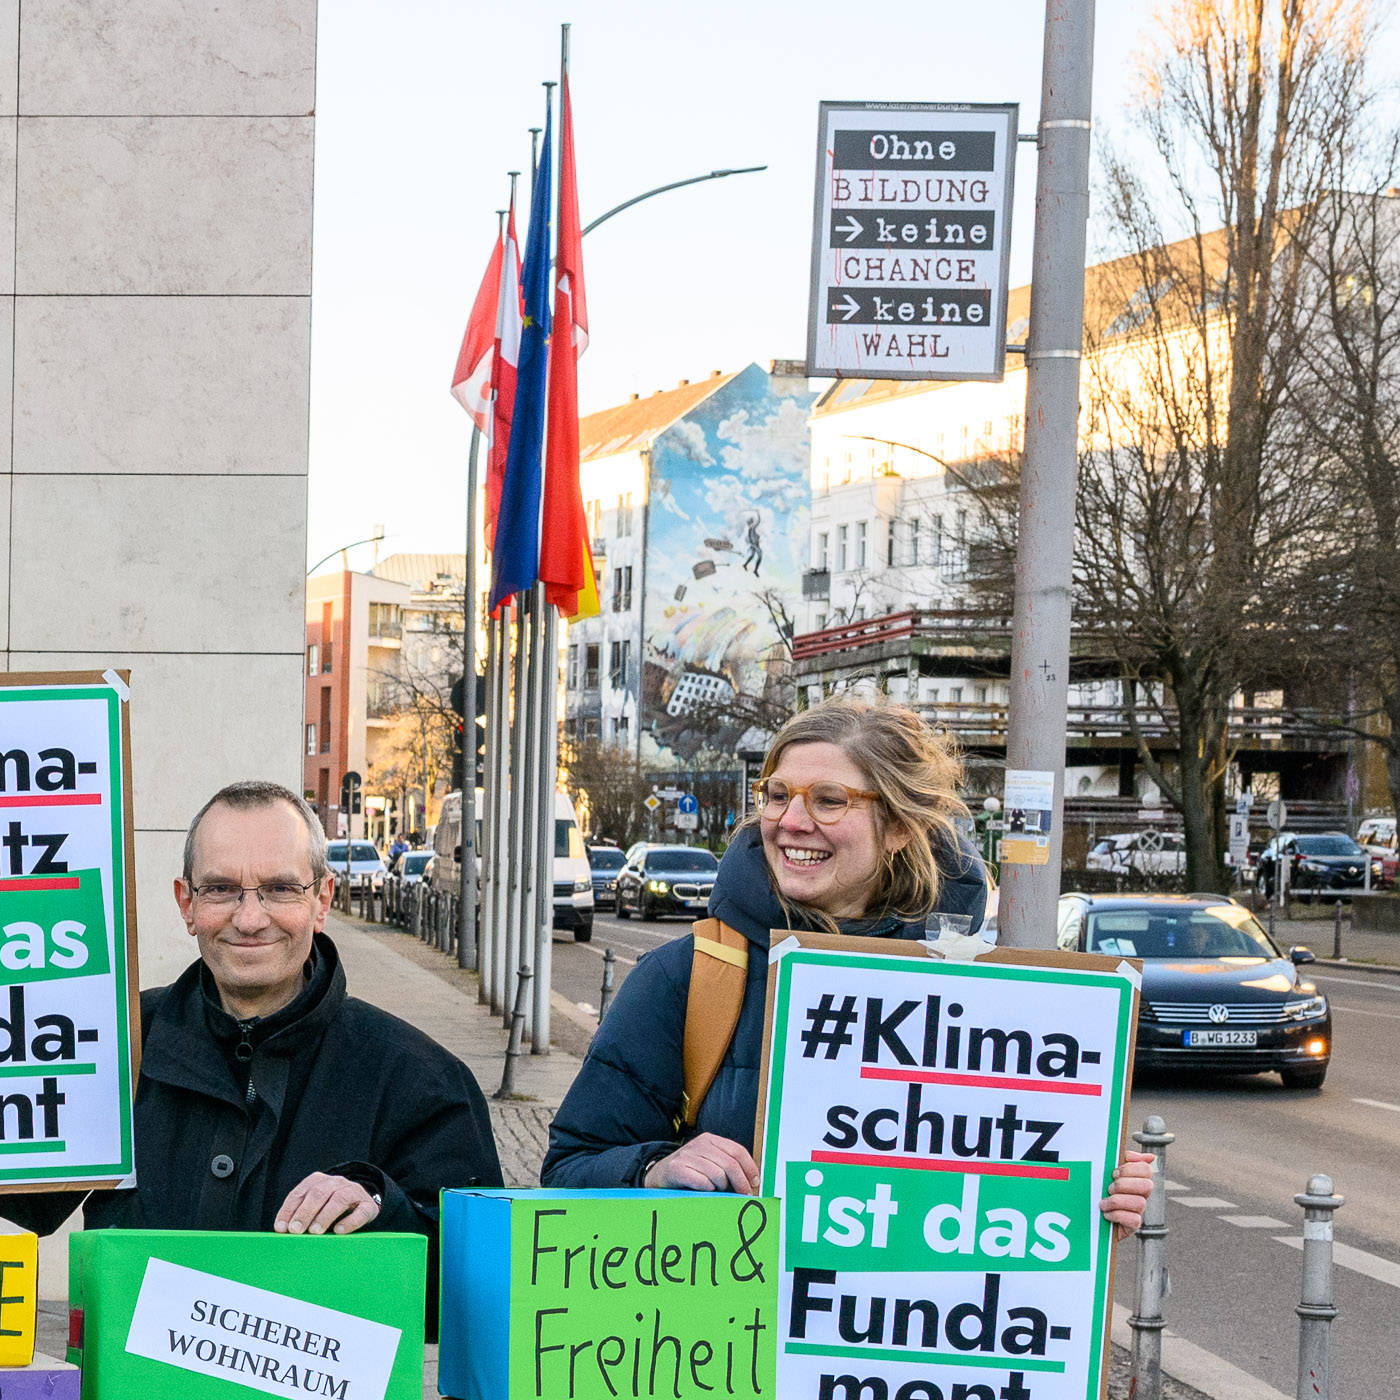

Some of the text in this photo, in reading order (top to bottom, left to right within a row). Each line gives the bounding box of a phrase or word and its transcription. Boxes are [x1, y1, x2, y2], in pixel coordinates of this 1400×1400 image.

[870, 134, 956, 160] Ohne
[833, 178, 989, 203] BILDUNG
[876, 218, 987, 243] keine
[844, 257, 976, 282] CHANCE
[873, 297, 983, 323] keine
[862, 333, 949, 358] WAHL
[801, 994, 1101, 1078] #Klima-
[823, 1084, 1064, 1163] schutz
[531, 1200, 767, 1290] Frieden &
[802, 1170, 1071, 1262] ist das
[190, 1299, 342, 1362] SICHERER
[789, 1267, 1071, 1355] Funda-
[536, 1308, 767, 1399] Freiheit
